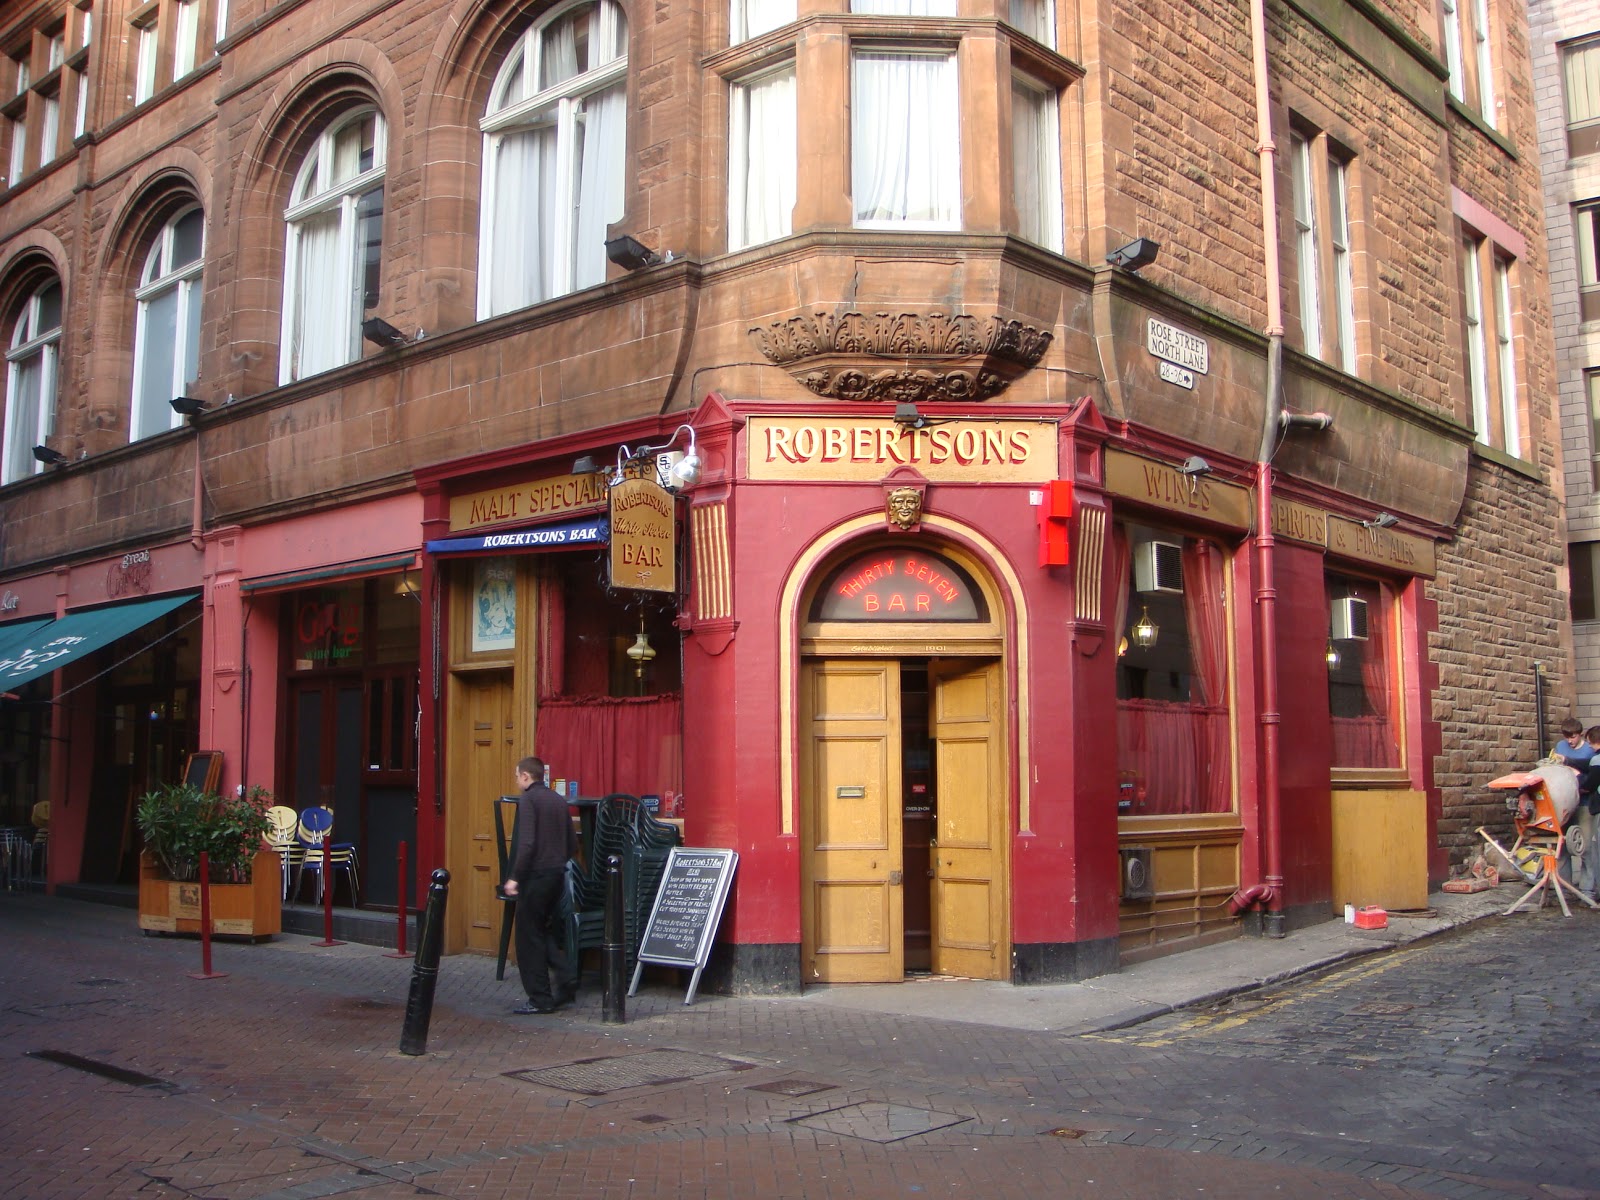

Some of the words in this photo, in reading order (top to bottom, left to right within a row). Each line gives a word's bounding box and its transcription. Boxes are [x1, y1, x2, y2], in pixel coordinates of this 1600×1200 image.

[1151, 321, 1171, 342] ROSE
[1175, 331, 1205, 355] STREET
[1152, 337, 1180, 361] NORTH
[1183, 349, 1204, 370] LANE
[765, 425, 1031, 466] ROBERTSONS
[614, 491, 672, 518] ROBERTSONS
[1143, 464, 1210, 512] WINES
[470, 492, 521, 525] MALT
[483, 530, 567, 547] ROBERTSONS
[569, 527, 598, 541] BAR
[613, 517, 640, 539] Thirty
[642, 521, 671, 540] Seven
[1336, 522, 1346, 548] &
[1355, 526, 1384, 559] FINE
[1389, 536, 1416, 565] ALES
[622, 543, 663, 568] BAR
[839, 559, 897, 601] THIRTY
[904, 559, 960, 604] SEVEN
[865, 593, 932, 613] BAR
[333, 644, 353, 659] bar
